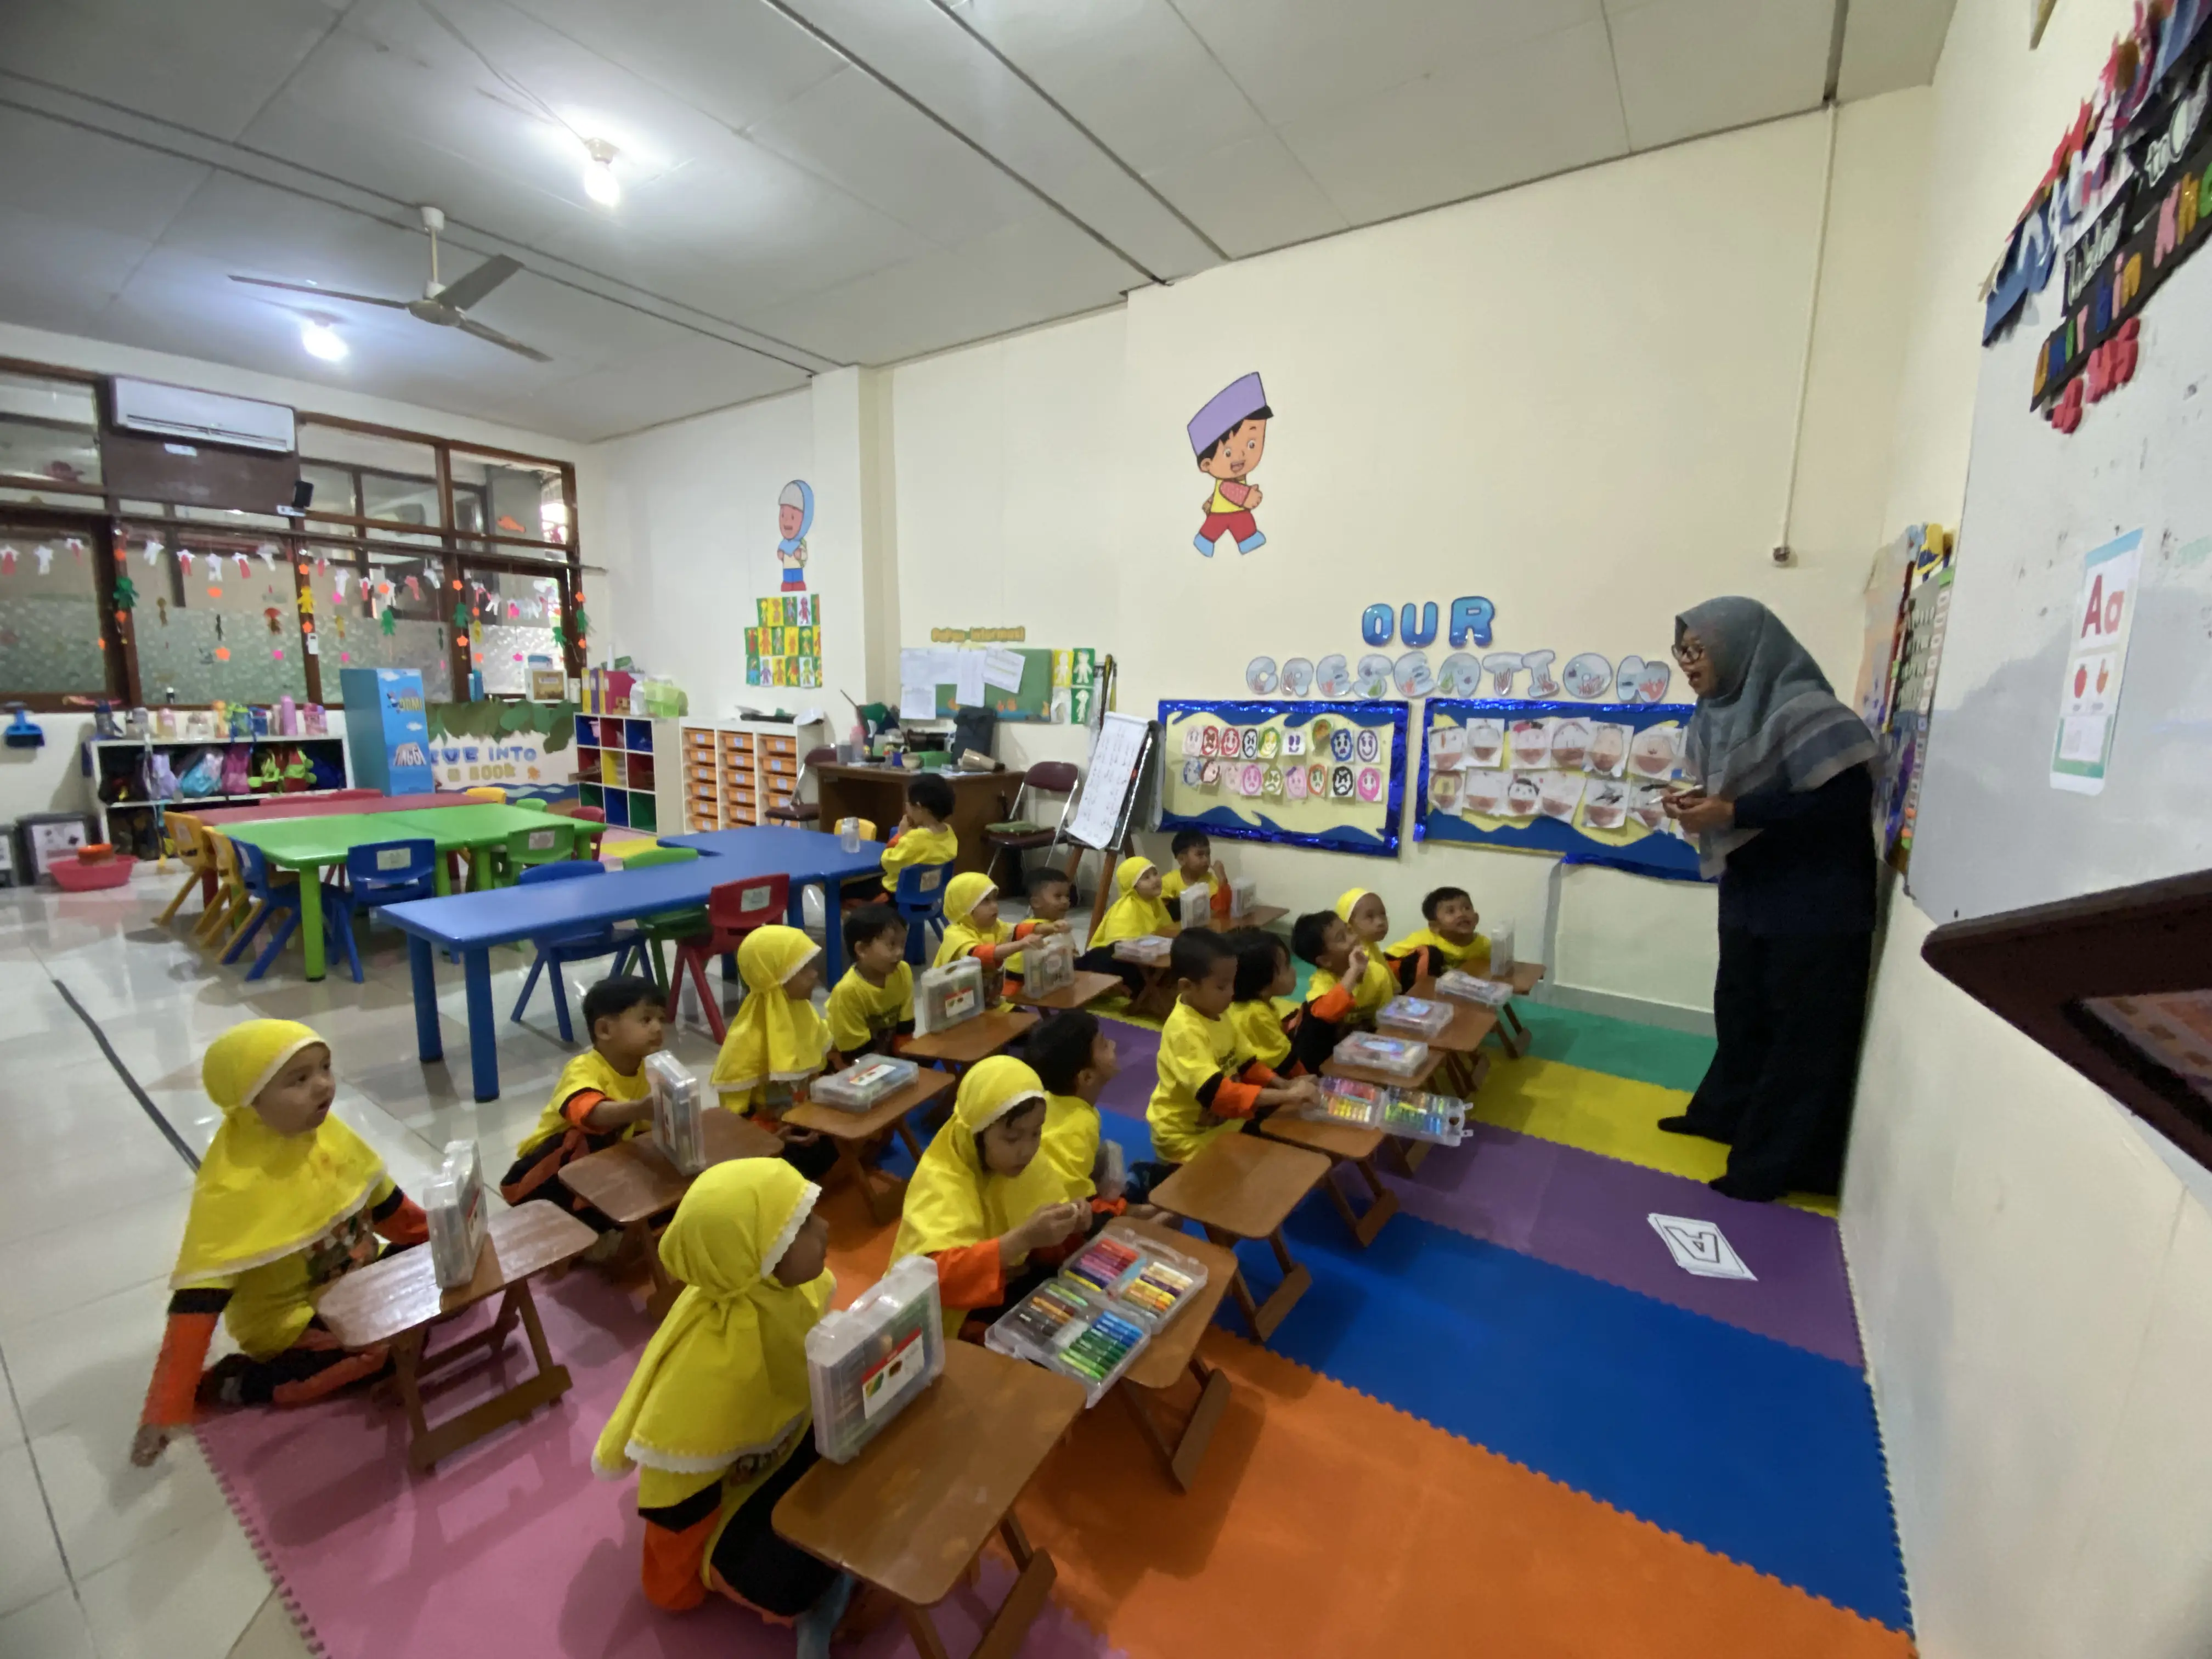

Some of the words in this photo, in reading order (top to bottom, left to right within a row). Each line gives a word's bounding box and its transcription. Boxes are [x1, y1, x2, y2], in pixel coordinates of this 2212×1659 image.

[1362, 596, 1496, 648] OUR
[2081, 573, 2125, 639] Aa
[488, 746, 537, 761] INTO
[1663, 1224, 1721, 1264] A
